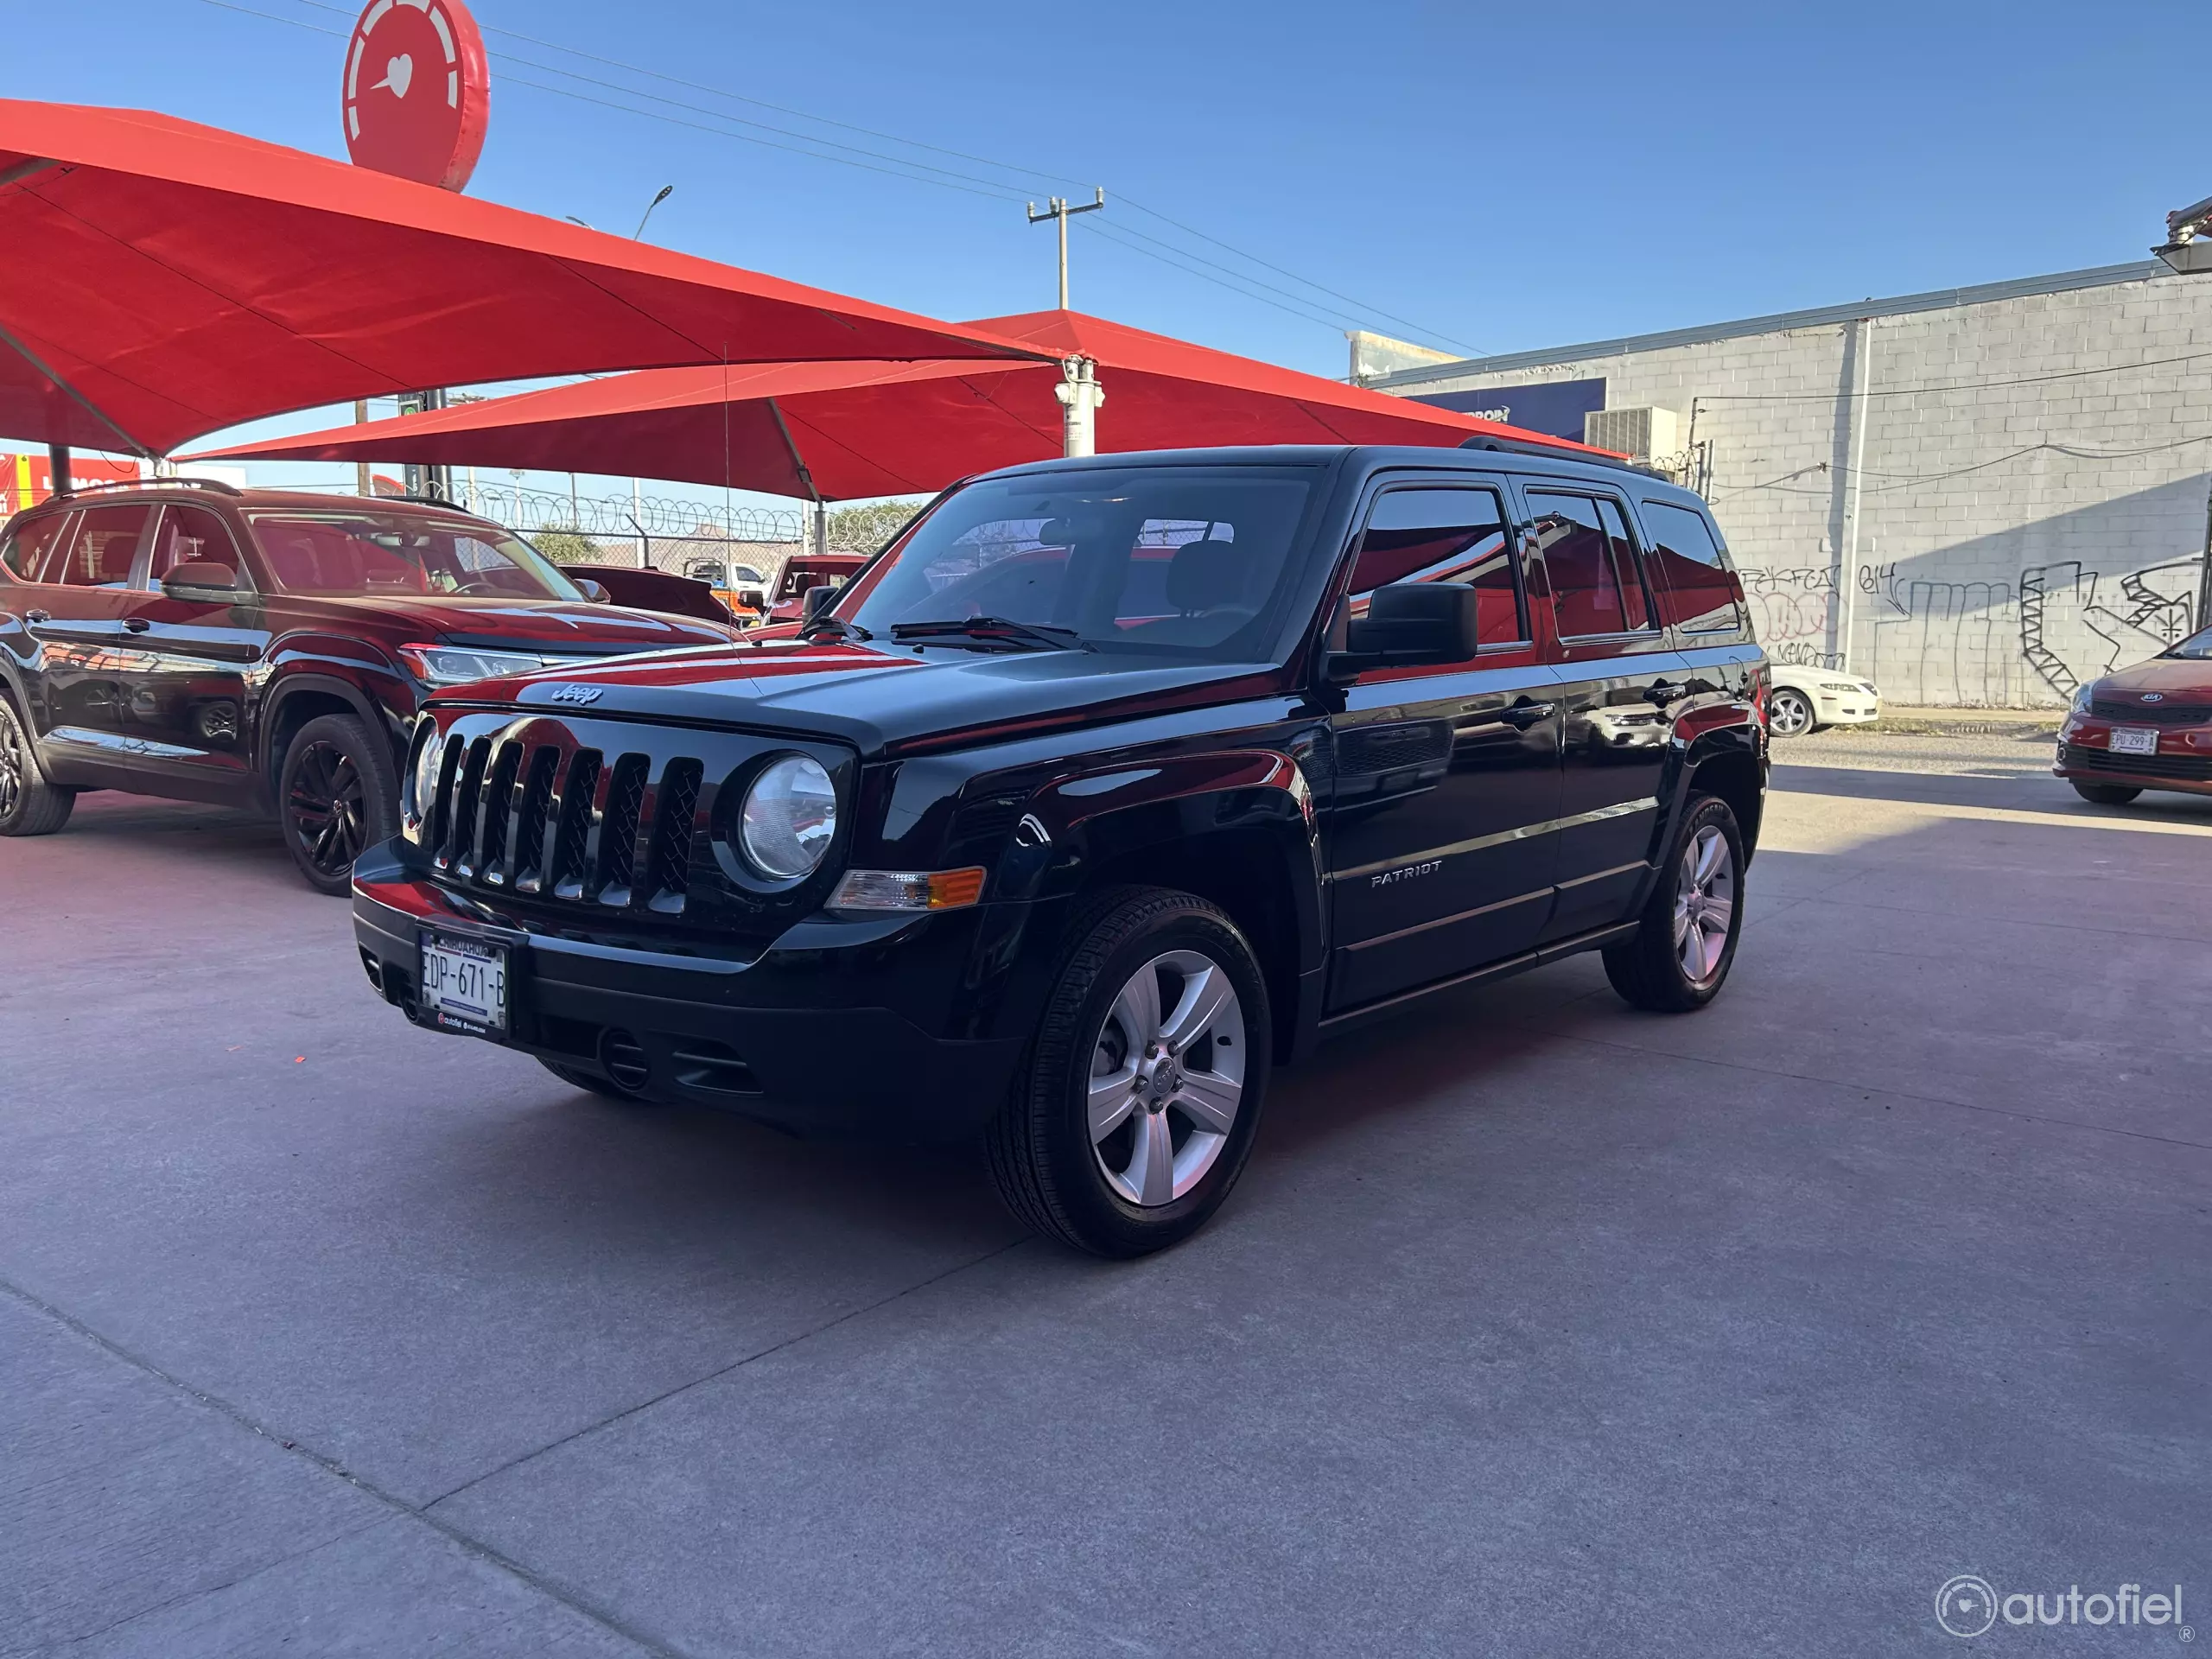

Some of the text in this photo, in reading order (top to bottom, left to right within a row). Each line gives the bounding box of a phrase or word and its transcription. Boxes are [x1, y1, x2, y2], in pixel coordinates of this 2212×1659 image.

[551, 684, 603, 706] Jeep
[1371, 861, 1442, 888] PATRIOT
[422, 951, 505, 1007] EDP-671-B
